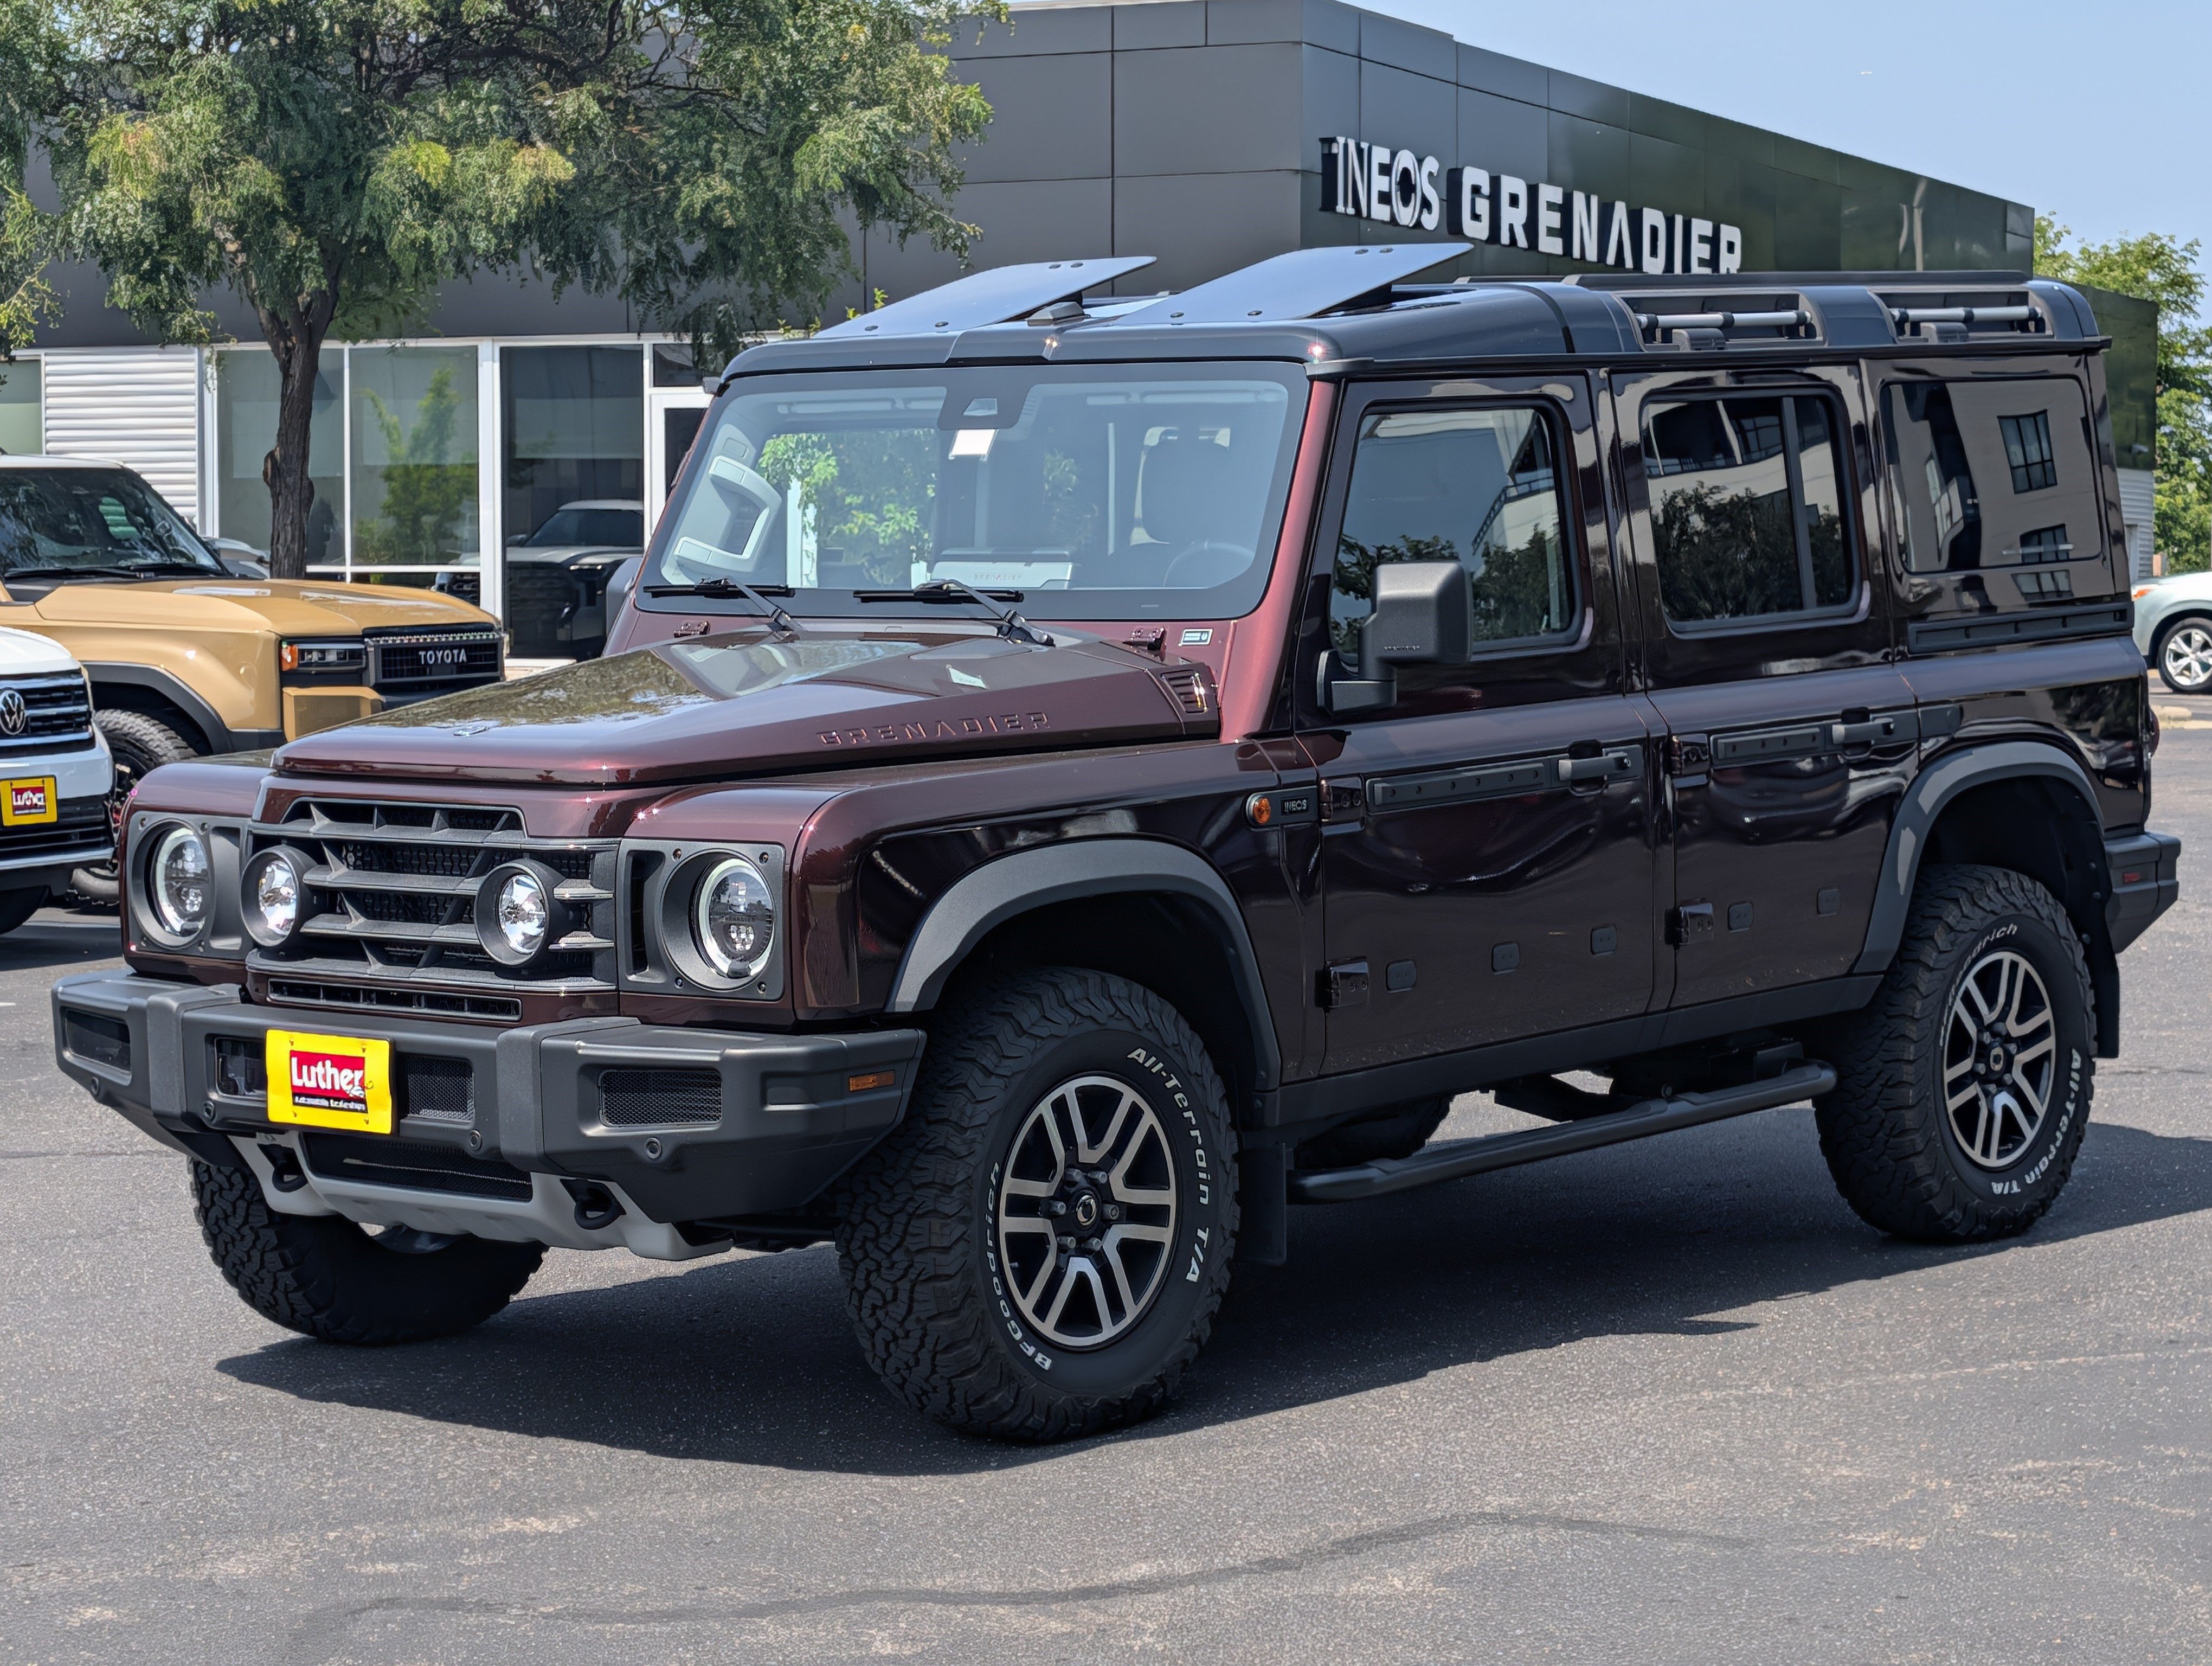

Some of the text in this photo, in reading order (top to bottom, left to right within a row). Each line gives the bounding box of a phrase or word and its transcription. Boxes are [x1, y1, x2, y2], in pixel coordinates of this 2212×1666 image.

[1335, 136, 1741, 274] INEOS GRENADIER
[418, 648, 467, 665] TOYOTA
[816, 712, 1051, 747] GRENADIER
[1284, 799, 1307, 812] INEOS
[291, 1056, 364, 1092] Luther
[1991, 1048, 2082, 1195] All-Terrain T/A
[1127, 1047, 1211, 1284] All-Terrain T/A
[985, 1161, 1052, 1371] BFGoodrich
